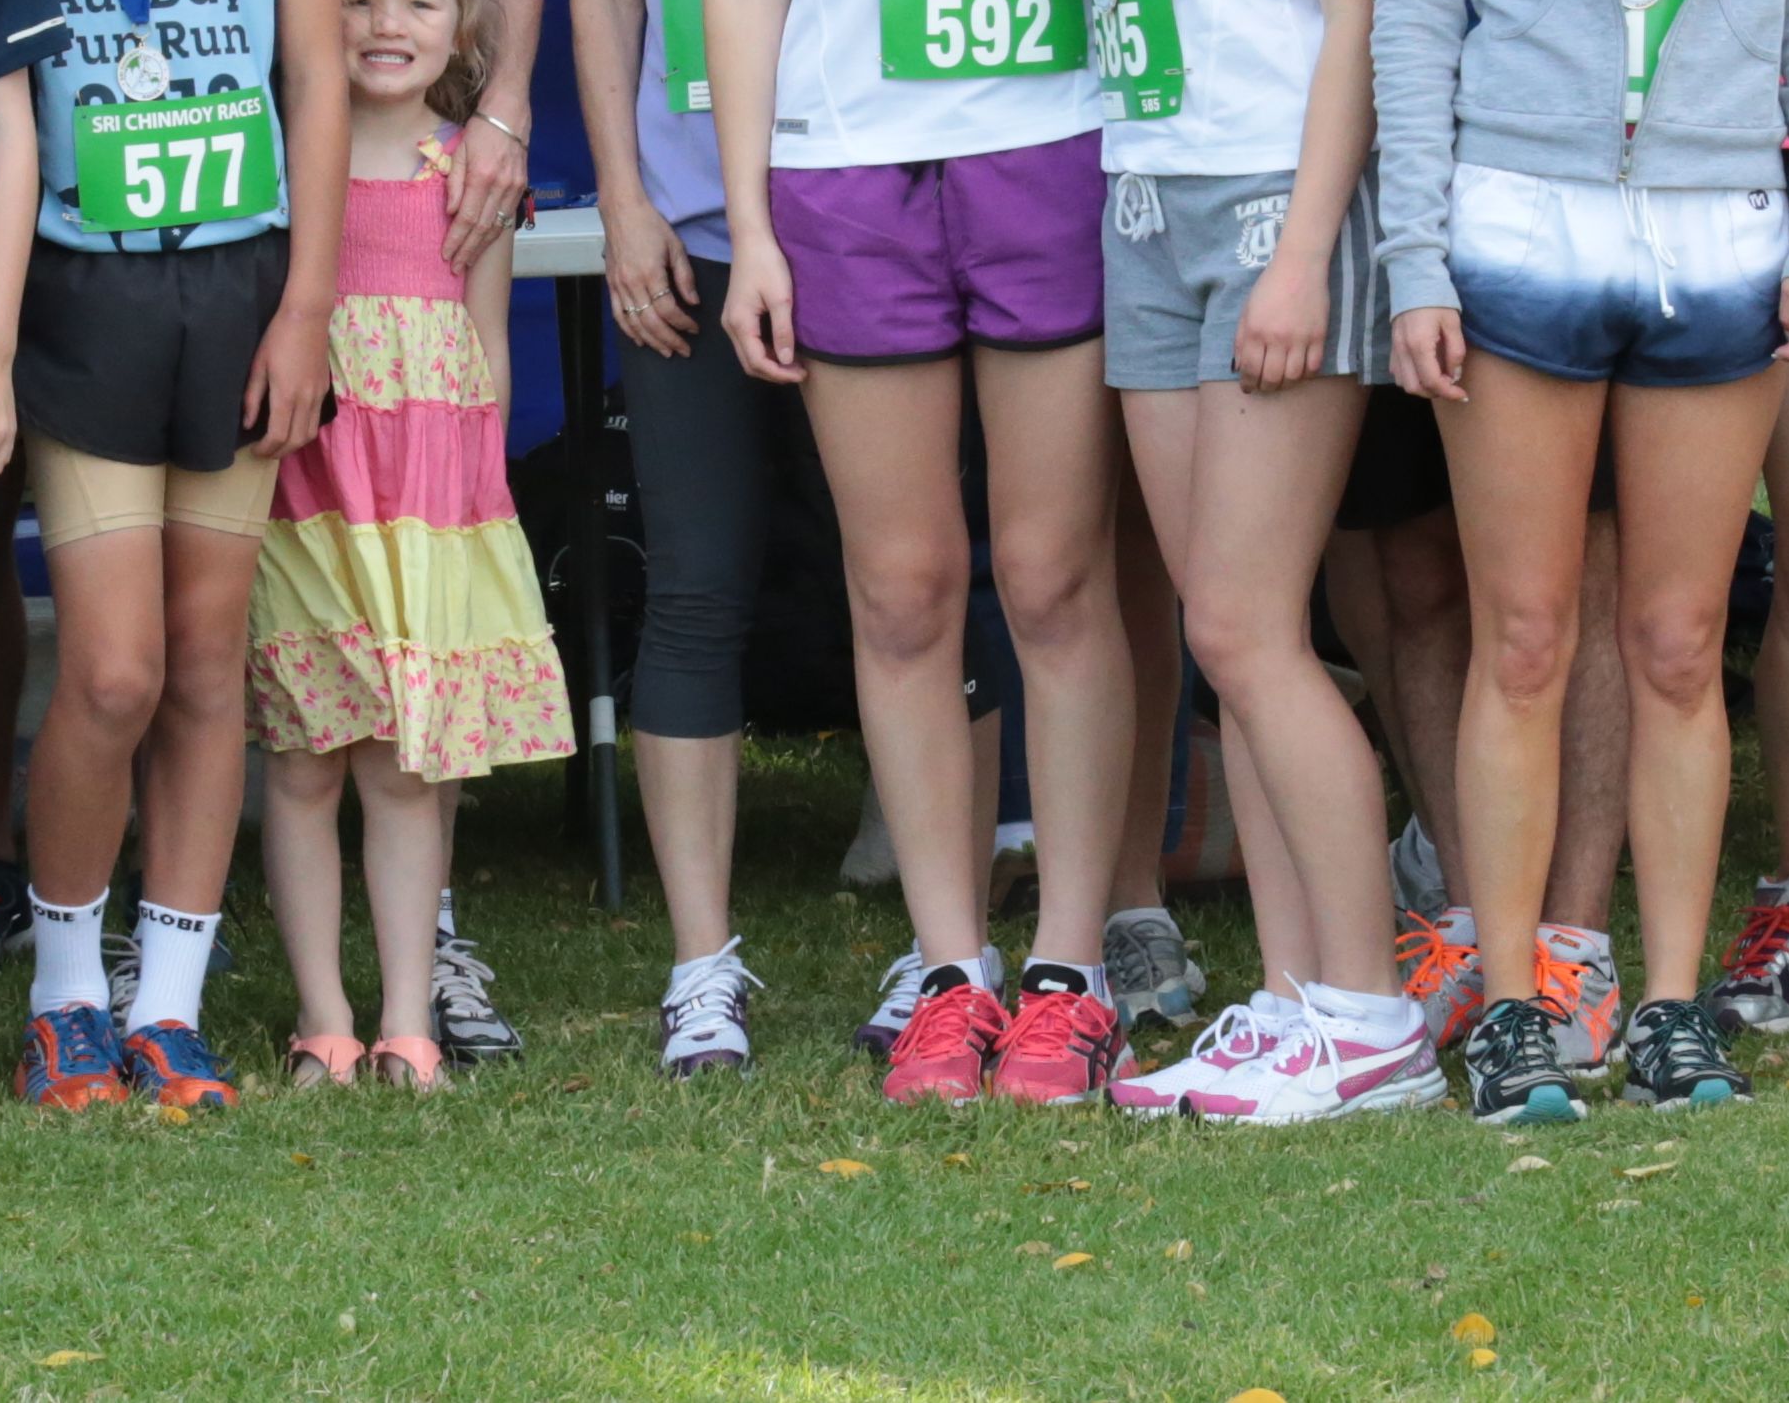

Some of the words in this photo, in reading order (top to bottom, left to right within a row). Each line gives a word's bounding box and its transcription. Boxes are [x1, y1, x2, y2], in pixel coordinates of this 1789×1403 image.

[154, 20, 251, 61] Run
[91, 114, 121, 134] SRI
[124, 105, 214, 132] CHINMOY
[217, 97, 262, 121] RACES
[1140, 97, 1161, 113] 585
[124, 131, 246, 218] 577
[33, 904, 76, 923] OBE
[139, 906, 206, 933] GLOBE
